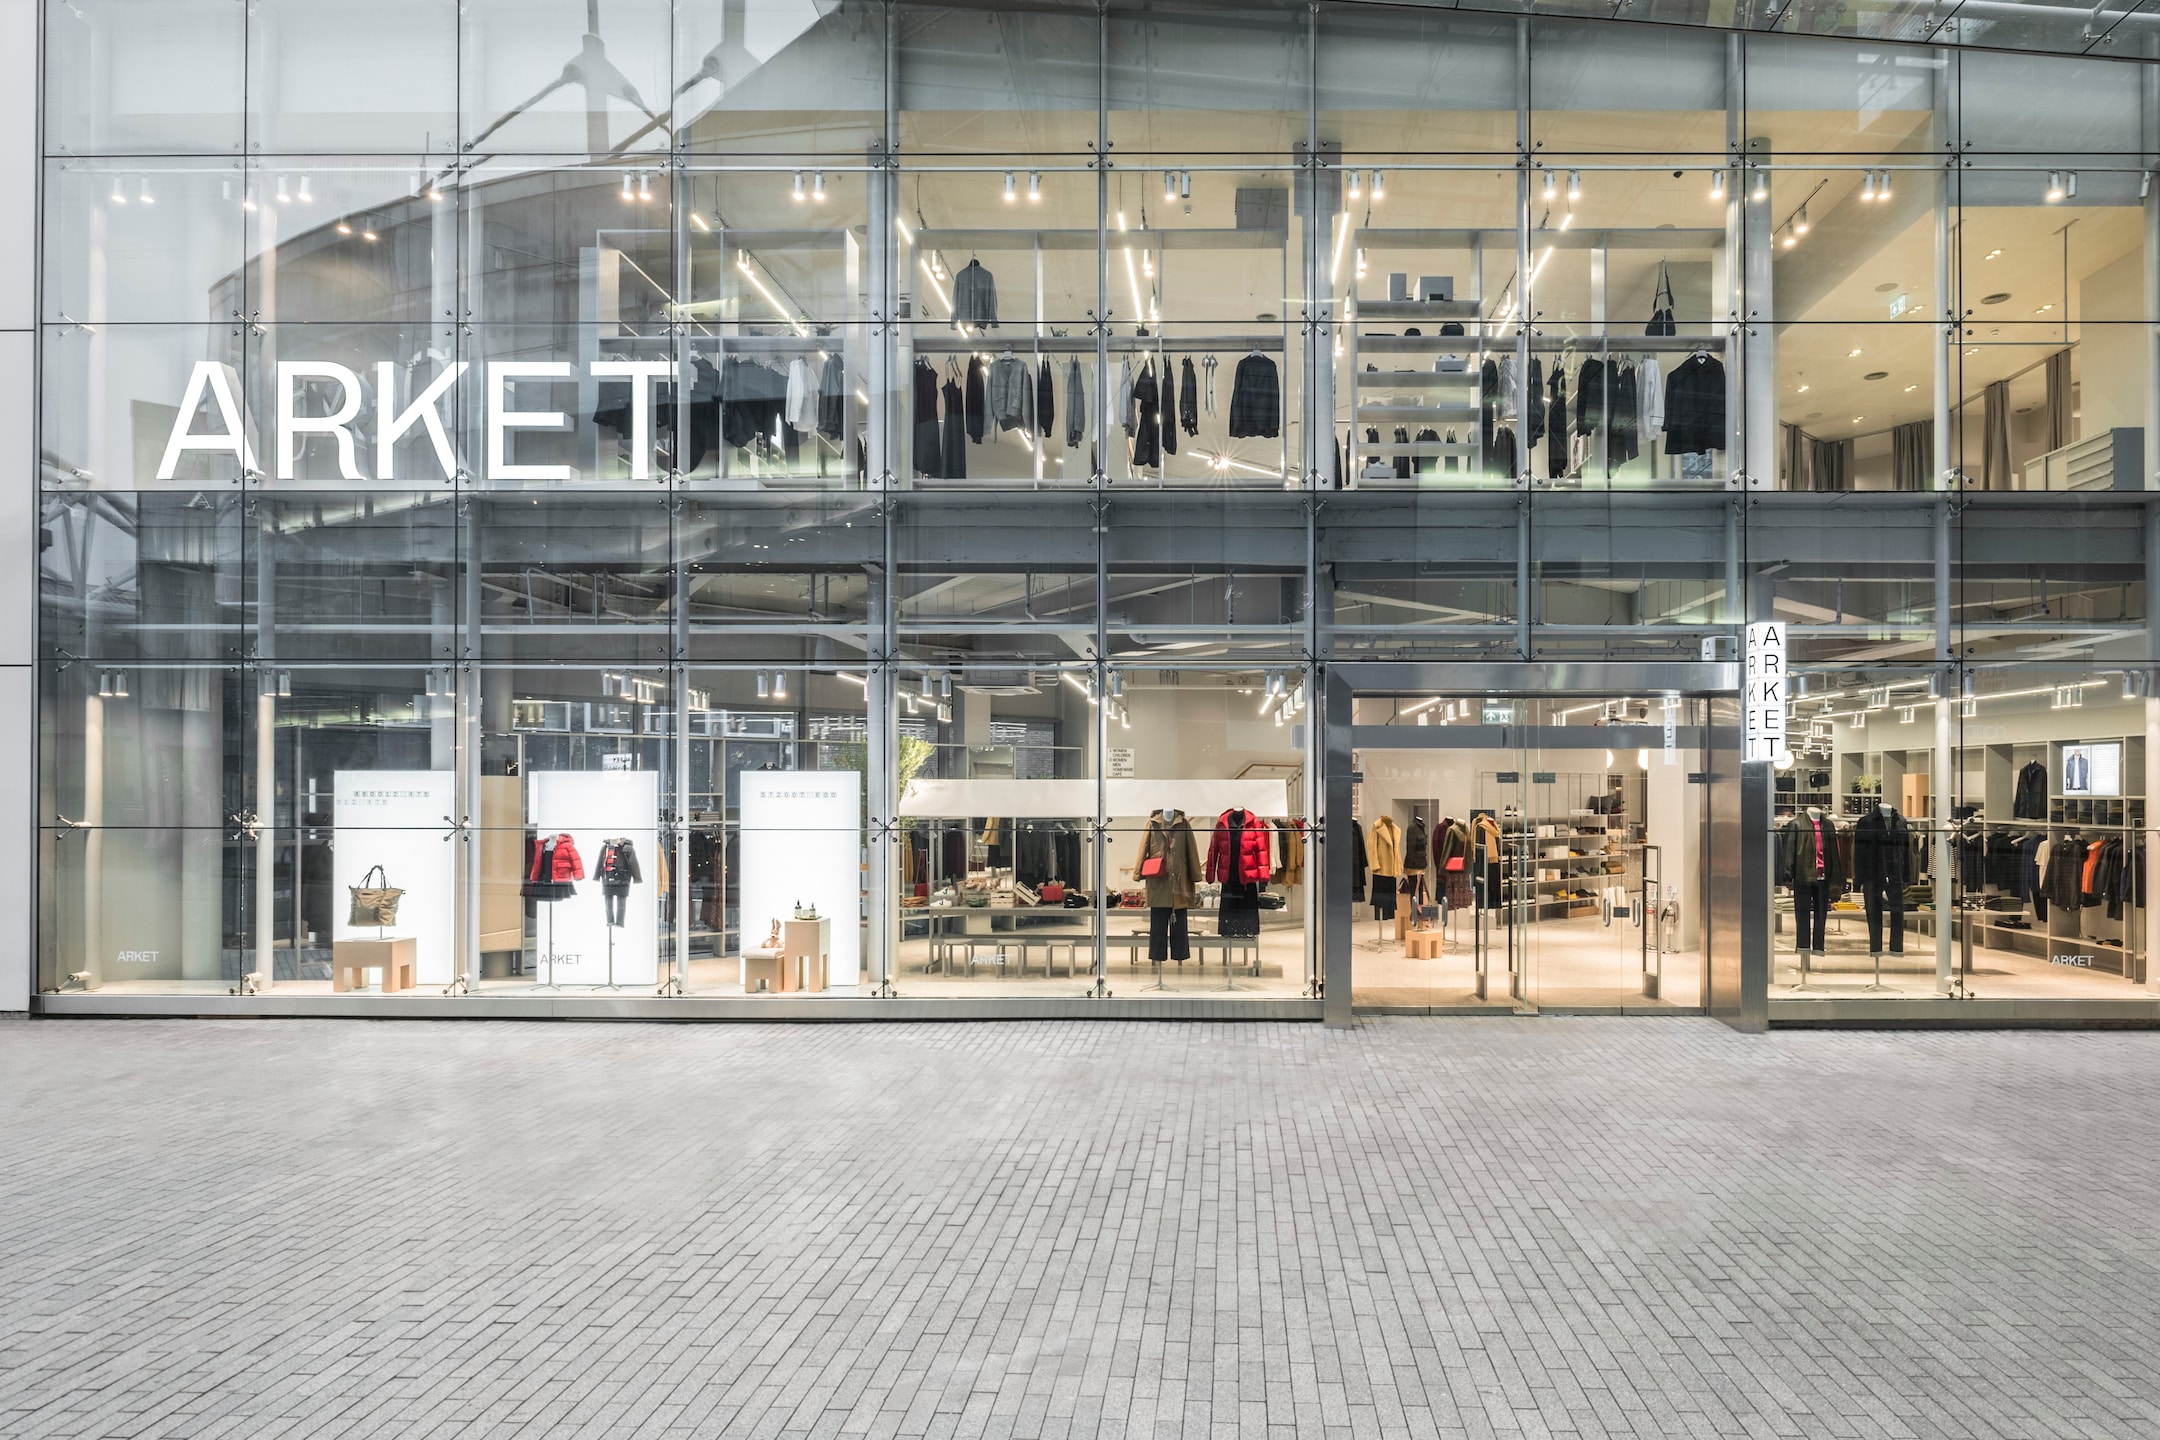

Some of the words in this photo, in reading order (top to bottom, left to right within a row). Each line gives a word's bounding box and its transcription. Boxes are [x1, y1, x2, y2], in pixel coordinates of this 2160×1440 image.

[156, 360, 679, 481] ARKET
[1748, 628, 1757, 758] ARKET
[1763, 626, 1781, 757] ARKET
[117, 951, 159, 962] ARKET
[540, 954, 582, 965] ARKET
[970, 954, 1012, 965] ARKET
[2051, 955, 2095, 967] ARKET
